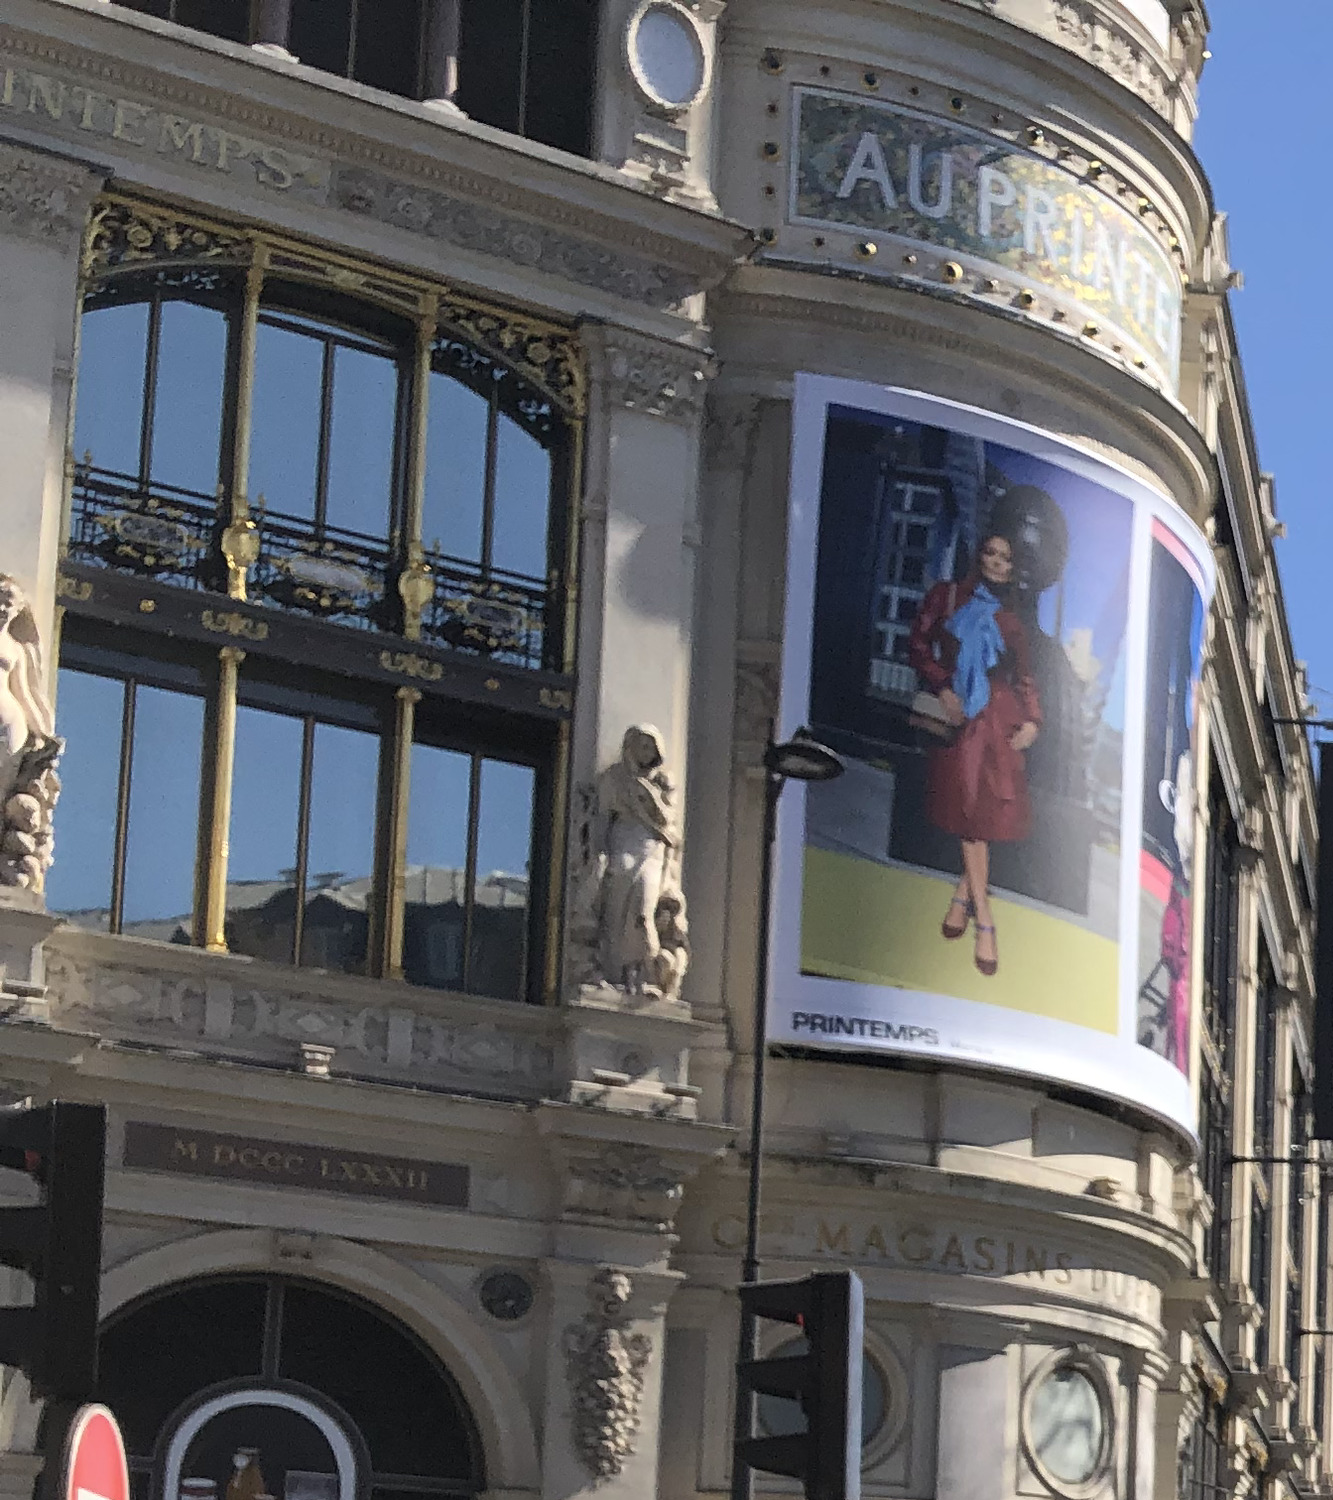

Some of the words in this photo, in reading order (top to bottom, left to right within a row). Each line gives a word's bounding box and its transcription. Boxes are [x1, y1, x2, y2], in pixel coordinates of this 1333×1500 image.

[836, 131, 954, 218] AU
[791, 1011, 939, 1046] PRINTEMPS
[174, 1138, 198, 1163] M
[213, 1143, 305, 1176] DCCC
[815, 1218, 1074, 1285] MAGASINS
